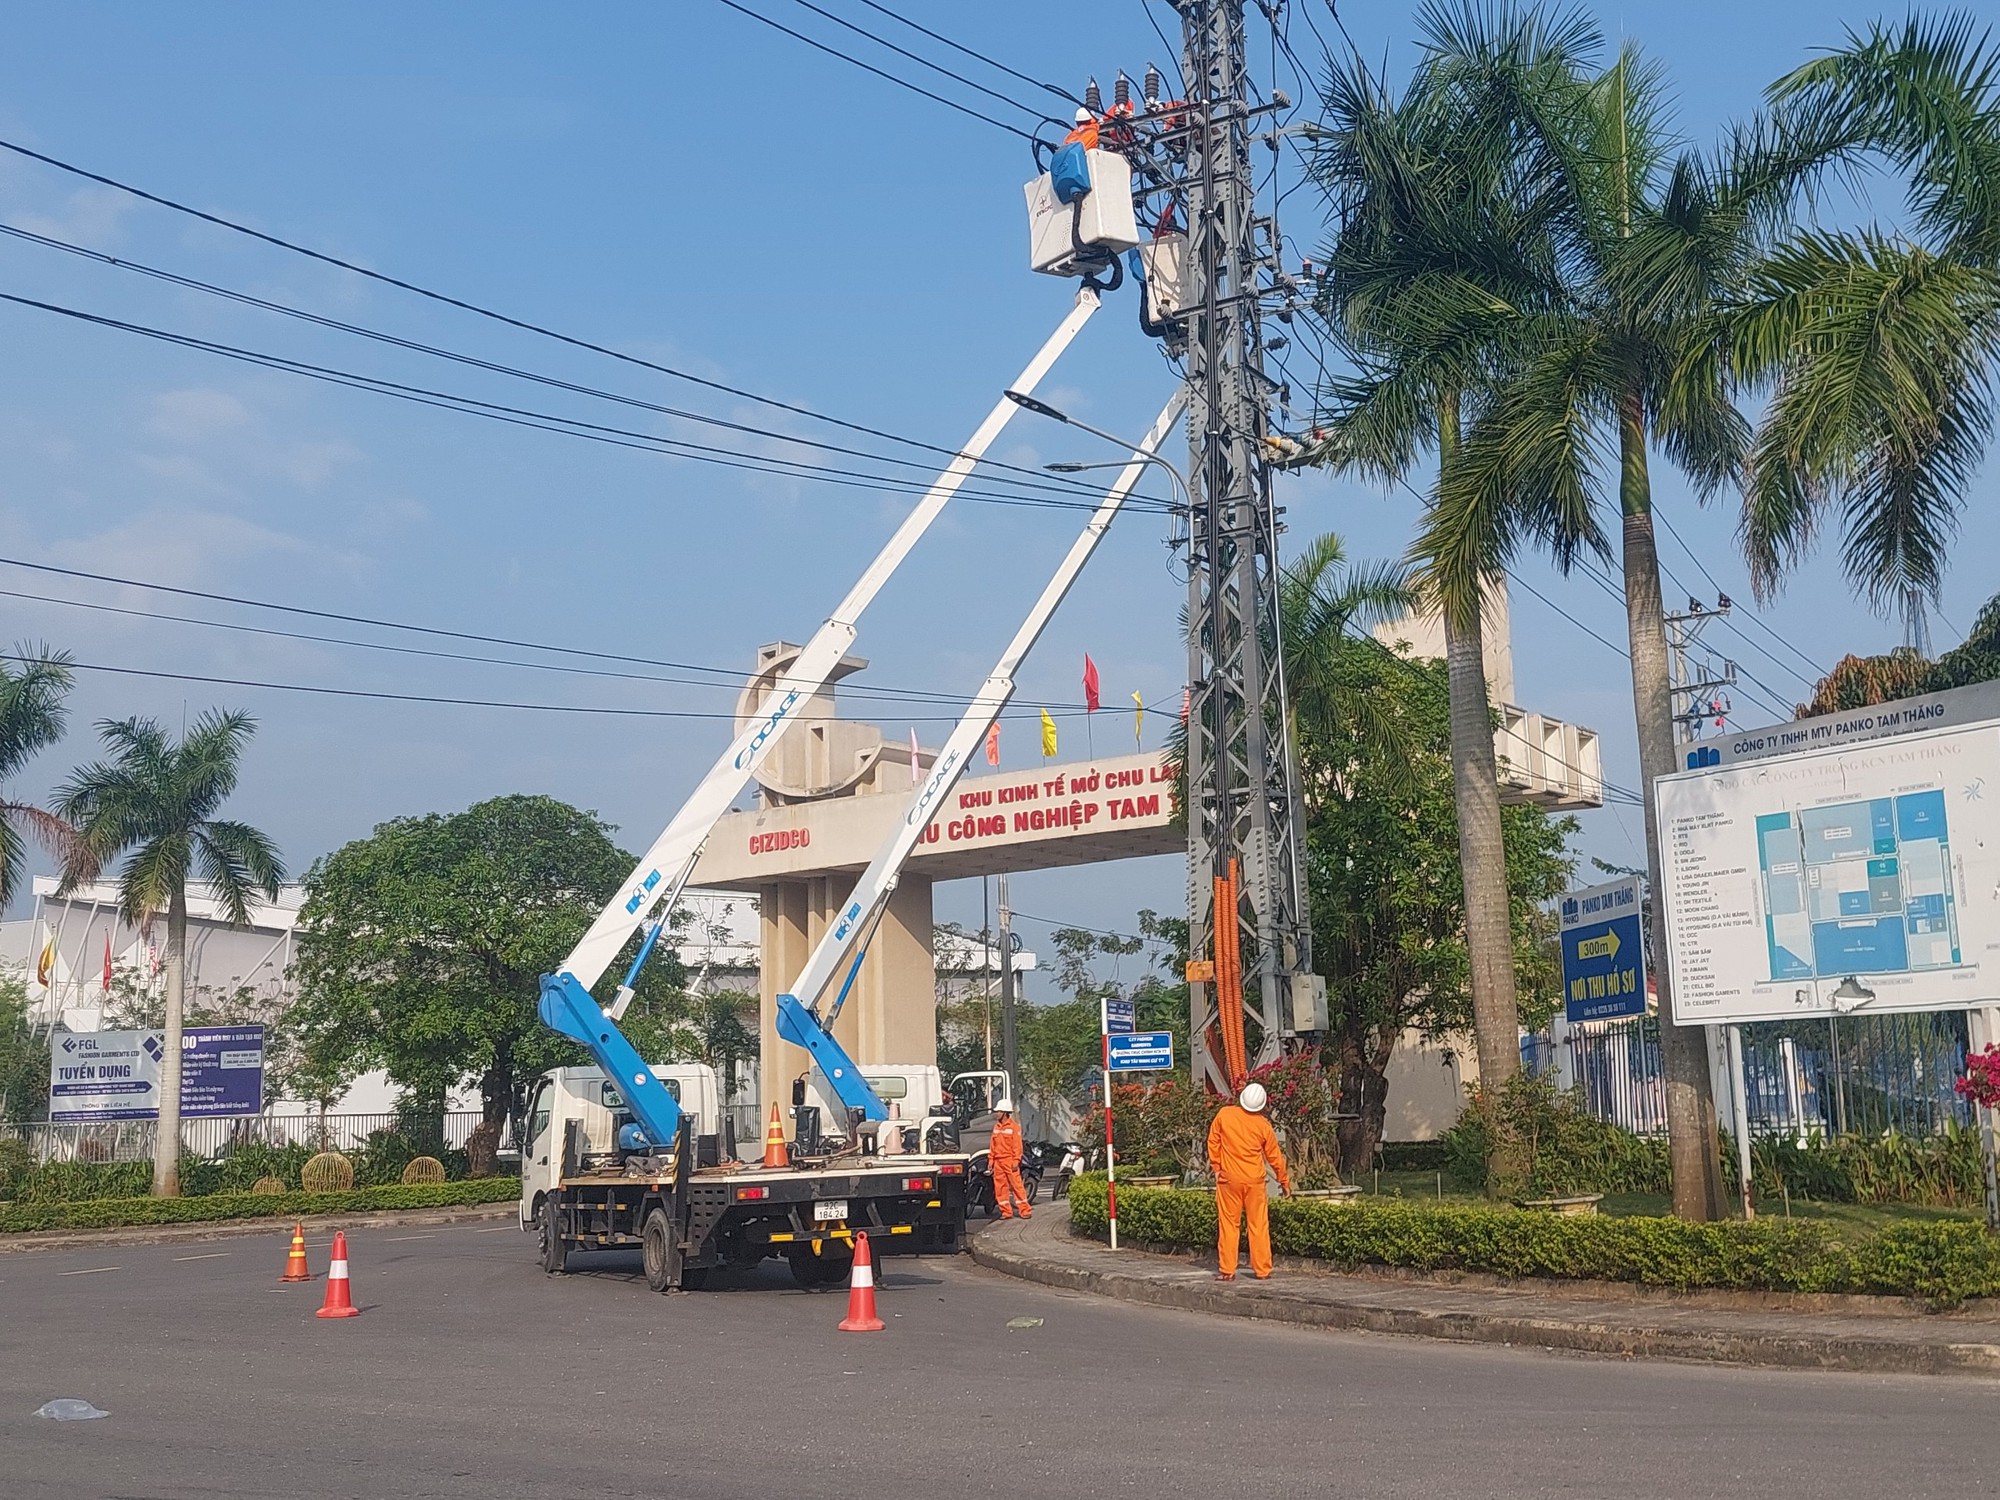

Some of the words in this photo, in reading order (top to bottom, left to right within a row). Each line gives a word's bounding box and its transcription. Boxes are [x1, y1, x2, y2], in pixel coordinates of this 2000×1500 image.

[735, 687, 799, 770] SOCAGE
[1734, 738, 1764, 754] CÔNG
[1767, 735, 1777, 747] TY
[1781, 730, 1808, 745] TNHH
[1812, 724, 1832, 740] MTV
[1836, 718, 1873, 735] PANKO
[1877, 712, 1899, 728] TAM
[1903, 704, 1944, 723] THĂNG
[908, 749, 959, 826] SOCAGE
[960, 791, 991, 810] KHU
[998, 784, 1038, 804] KINH
[1044, 773, 1065, 798] TẾ
[1072, 768, 1100, 794] MỞ
[1106, 769, 1143, 790] CHU
[948, 814, 1005, 841] CÔNG
[1015, 800, 1098, 831] NGHIỆP
[1107, 794, 1159, 821] TAM
[1715, 819, 1733, 827] PANKO
[750, 828, 810, 856] CIZIDCO
[1582, 896, 1600, 915] PANKO
[1601, 892, 1613, 910] TAM
[1563, 913, 1579, 927] PANKO
[1584, 941, 1608, 956] 300m
[1571, 976, 1586, 1002] NƠI
[1587, 975, 1605, 999] THU
[1622, 967, 1635, 994] SƠ
[78, 1039, 99, 1050] FGL
[59, 1061, 95, 1080] TUYỂN
[99, 1065, 130, 1081] DỤNG
[820, 1210, 844, 1218] 184.24
[824, 1201, 838, 1210] 92C
